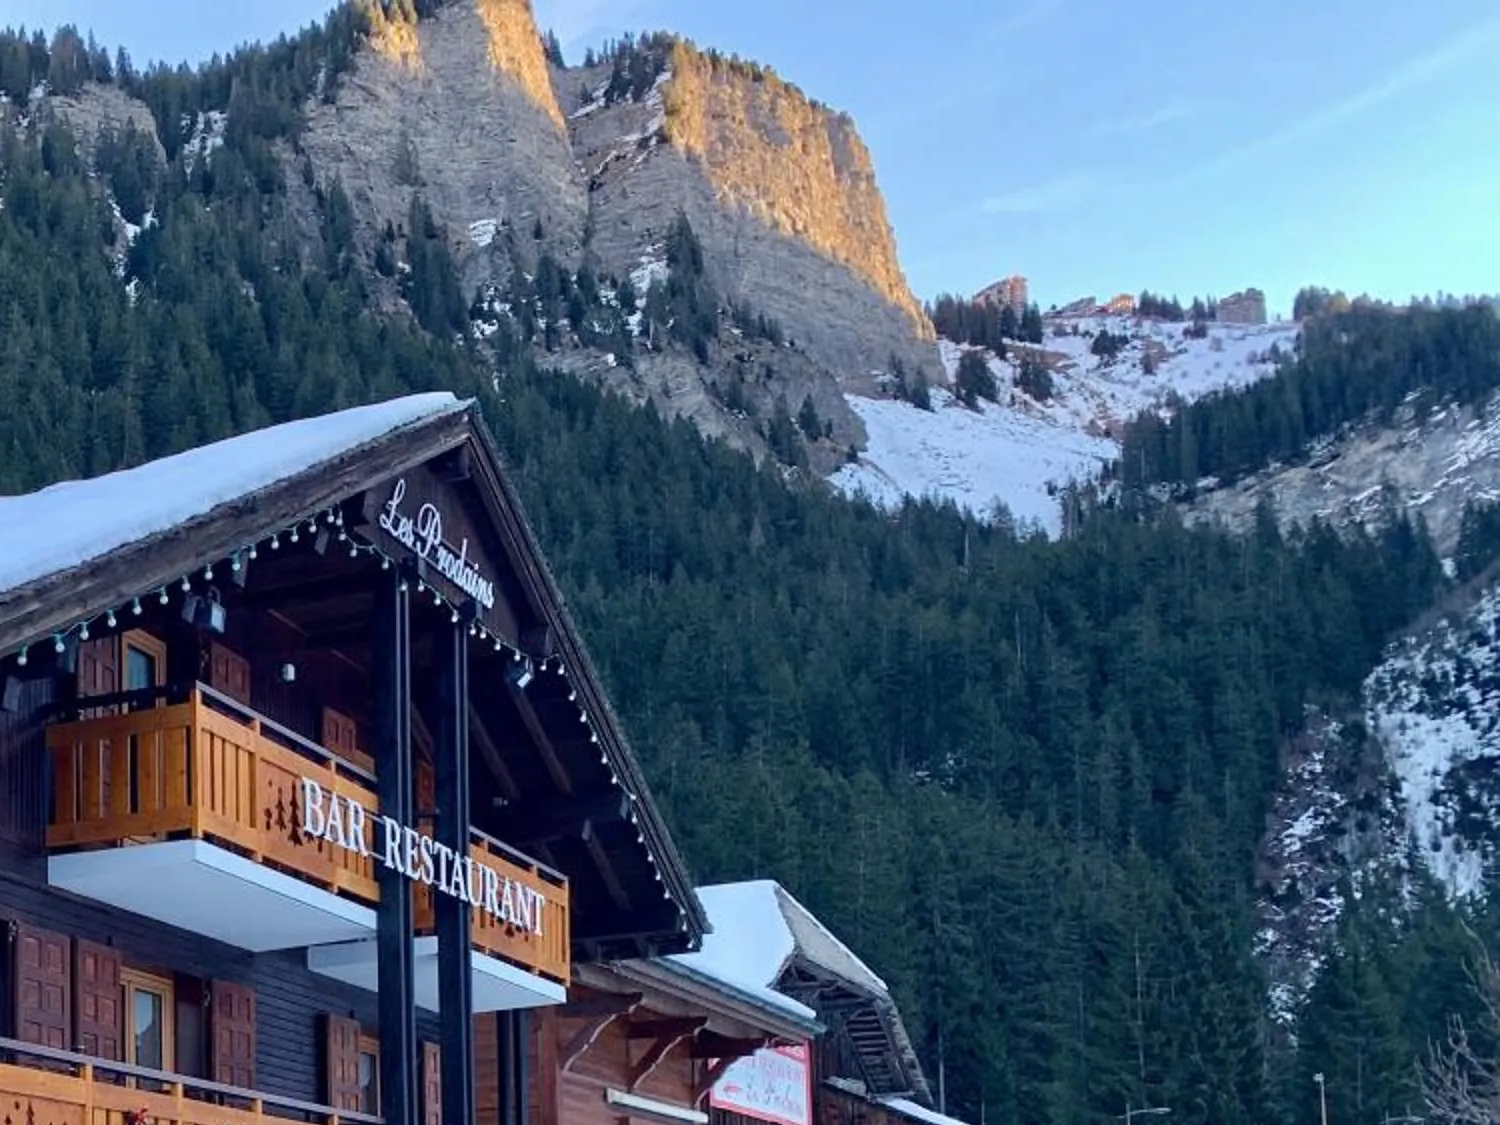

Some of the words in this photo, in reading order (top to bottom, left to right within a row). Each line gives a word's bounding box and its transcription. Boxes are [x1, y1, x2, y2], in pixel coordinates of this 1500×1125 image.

[379, 479, 415, 547] Les
[416, 503, 495, 609] Prodains
[302, 776, 368, 857] BAR
[382, 815, 546, 936] RESTAURANT
